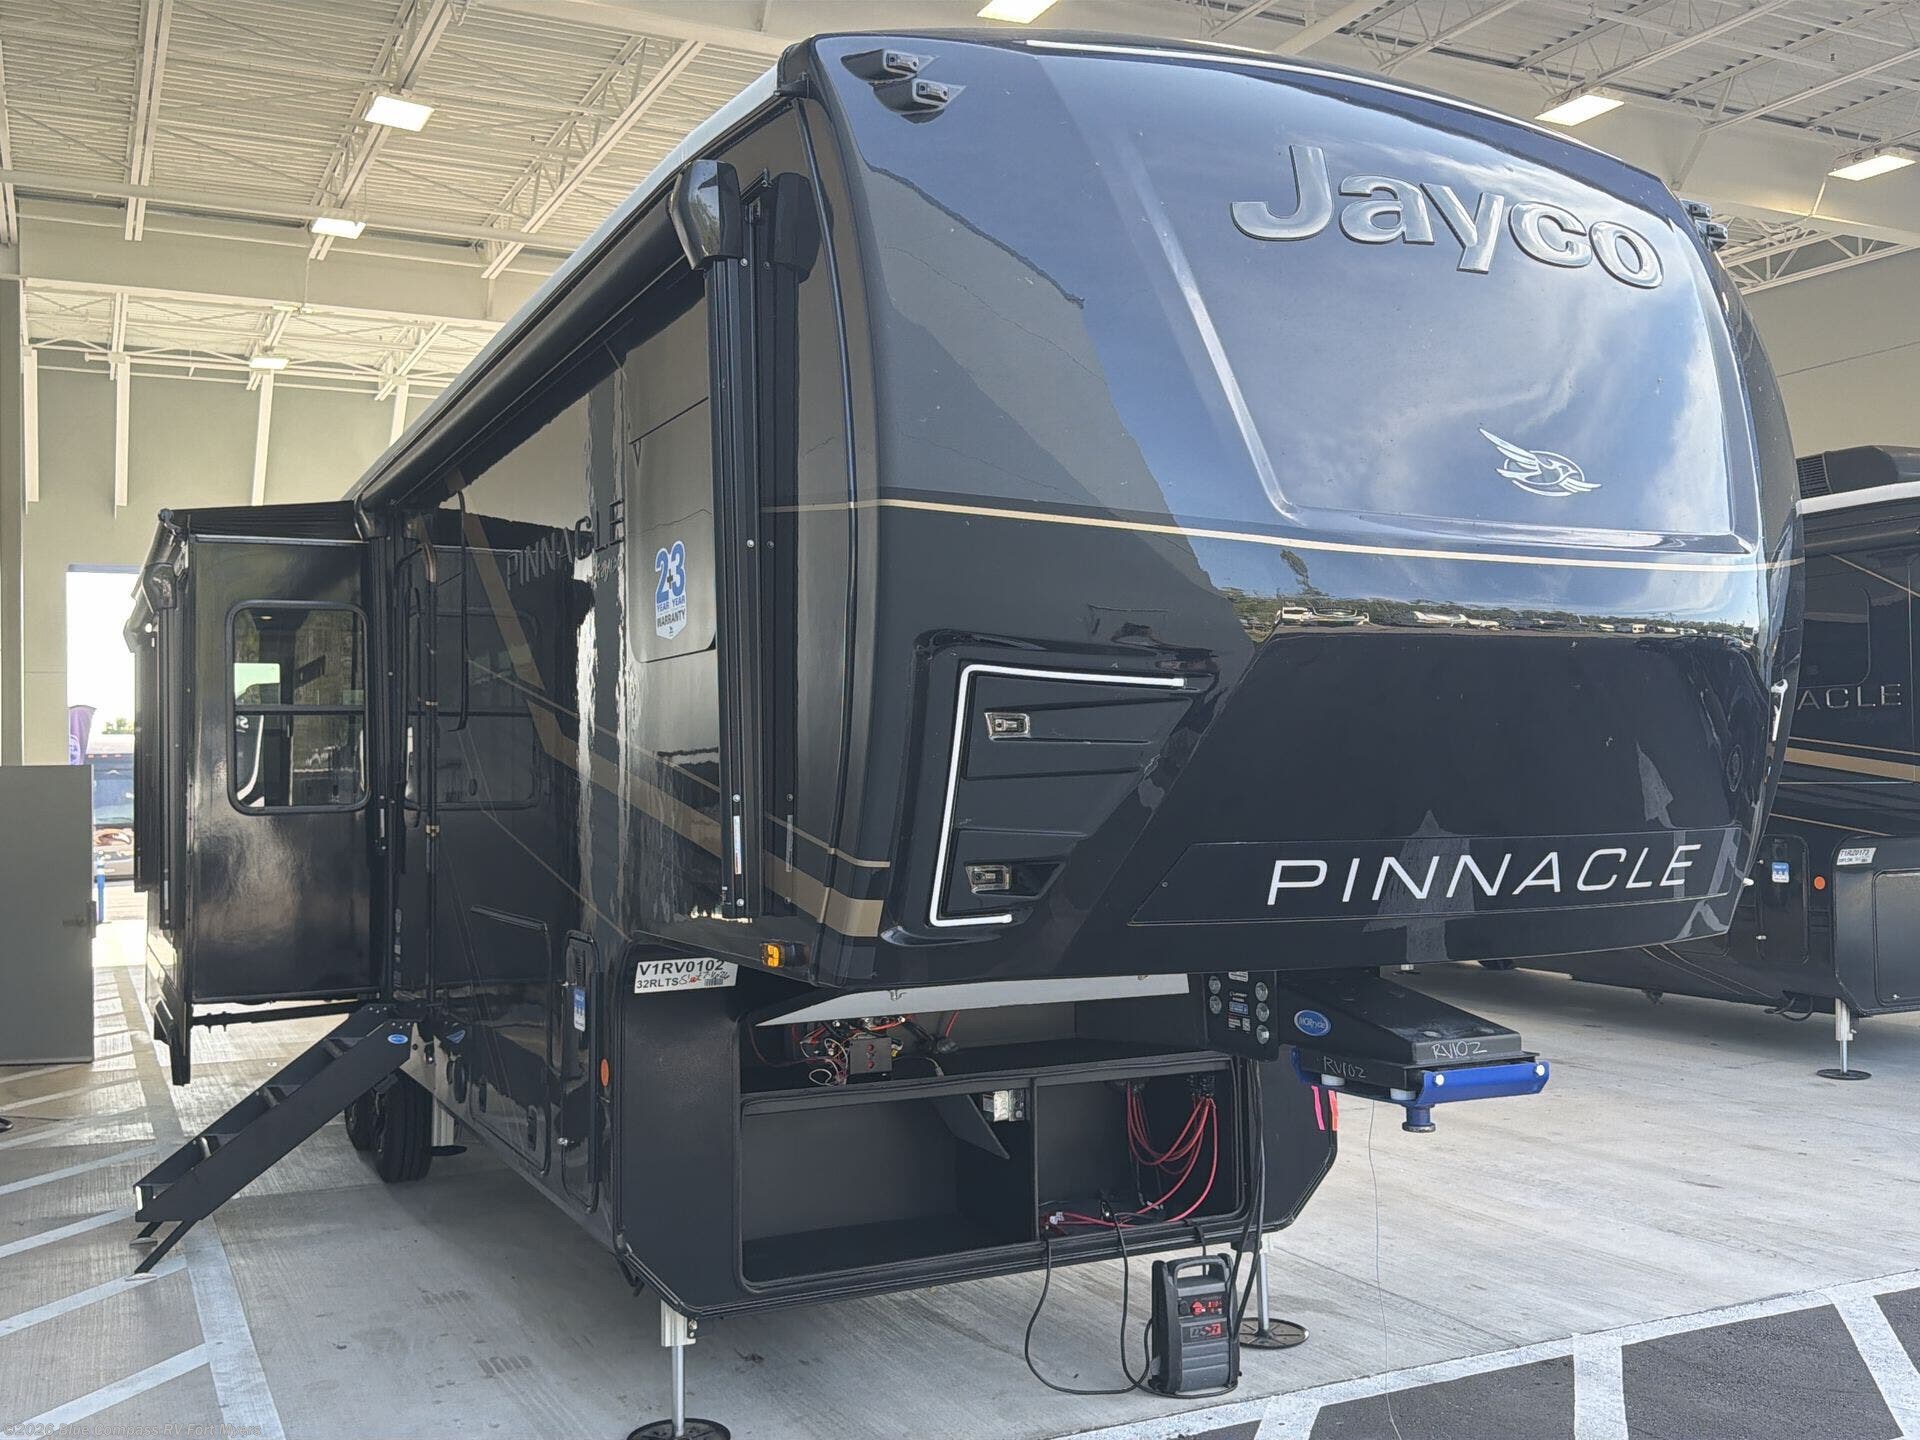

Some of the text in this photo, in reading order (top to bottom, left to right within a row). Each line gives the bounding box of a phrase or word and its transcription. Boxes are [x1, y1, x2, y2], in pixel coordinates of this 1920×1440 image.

[1231, 144, 1665, 289] Jayco
[506, 498, 626, 591] PINNACLE
[657, 595, 685, 614] YEAR YEAR
[657, 608, 686, 628] WARRANTY
[1797, 683, 1901, 710] ACLE
[1267, 844, 1702, 906] PINNACLE
[639, 959, 725, 976] V1RV0102
[636, 977, 679, 989] 32RLTS
[1432, 1041, 1488, 1059] RV102
[1323, 1055, 1367, 1079] RV102
